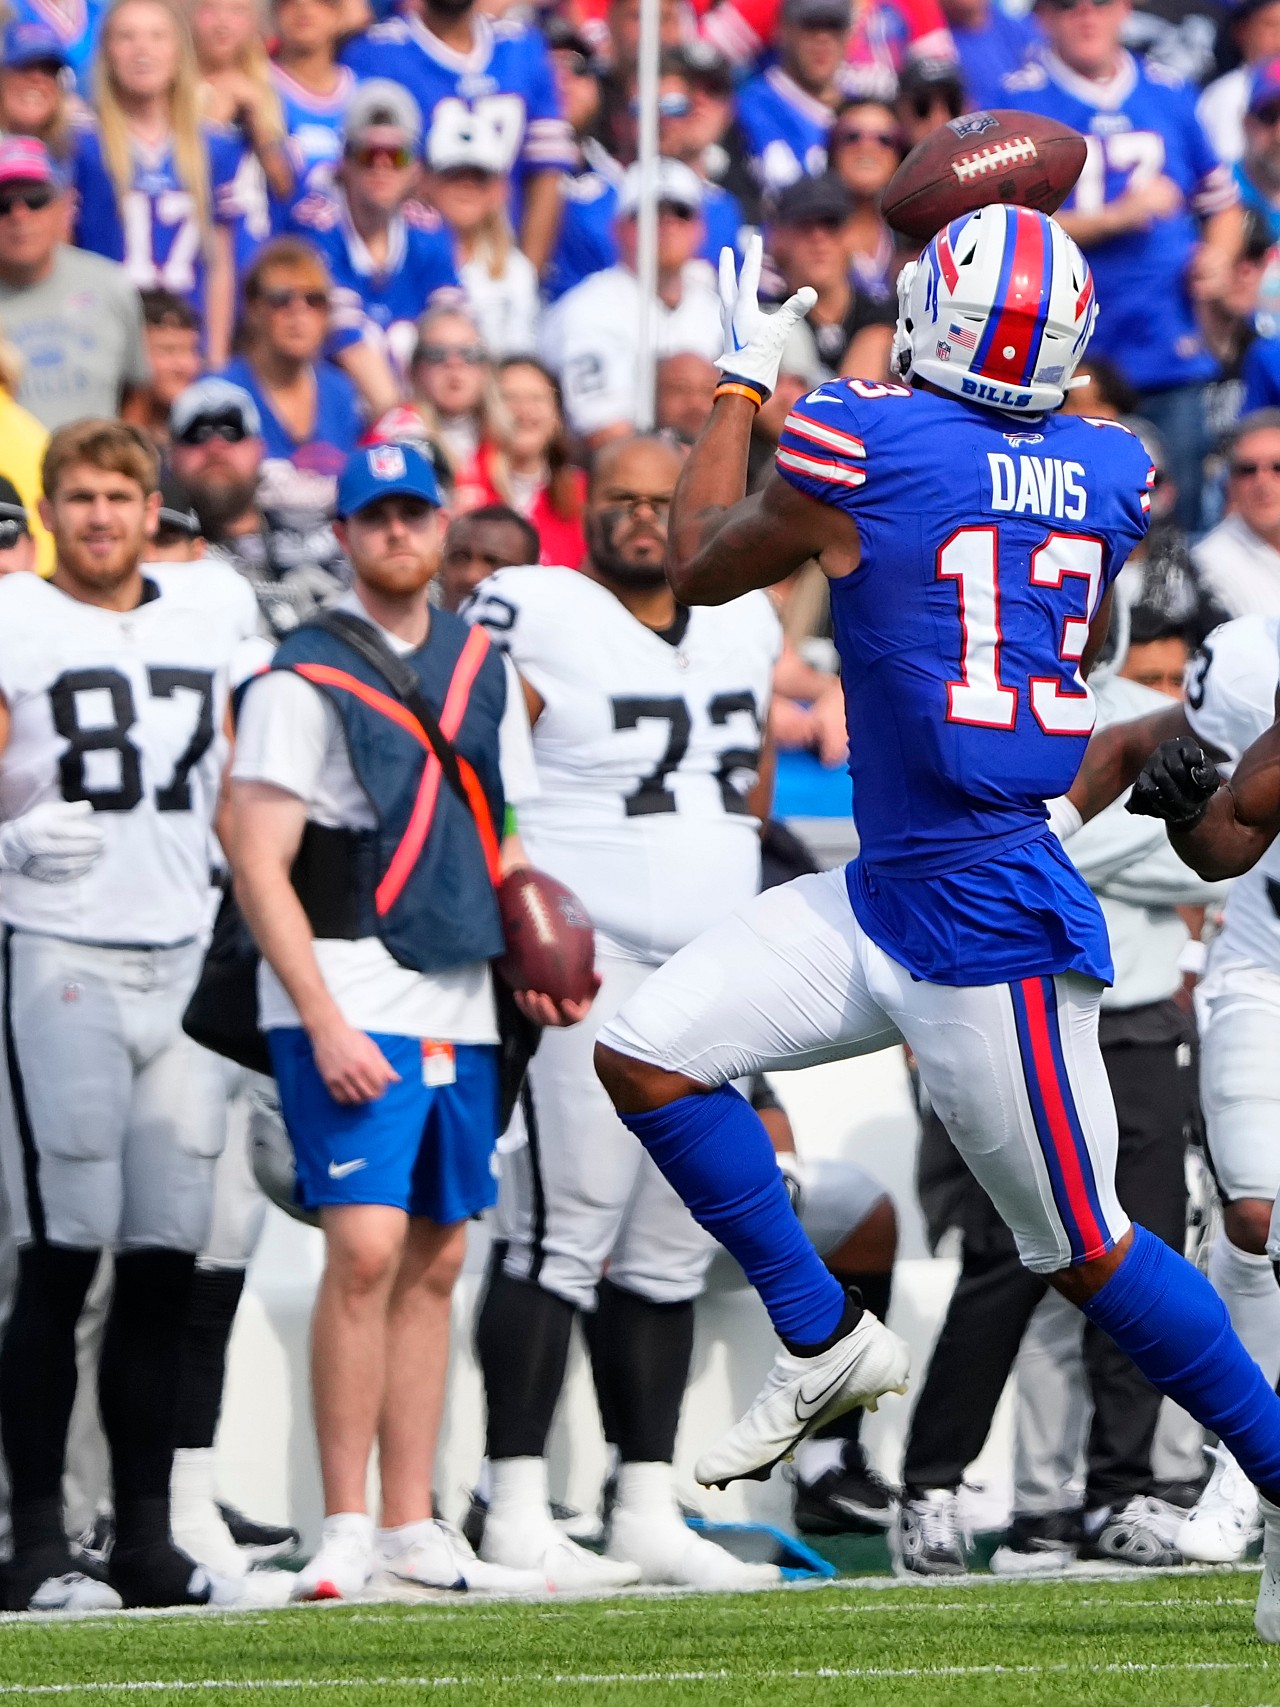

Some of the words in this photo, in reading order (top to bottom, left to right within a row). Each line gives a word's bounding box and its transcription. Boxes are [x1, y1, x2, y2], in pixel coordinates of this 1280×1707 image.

[961, 377, 1033, 408] BILLS
[986, 452, 1087, 521] DAVIS
[935, 524, 1108, 737] 13
[47, 664, 215, 813] 87
